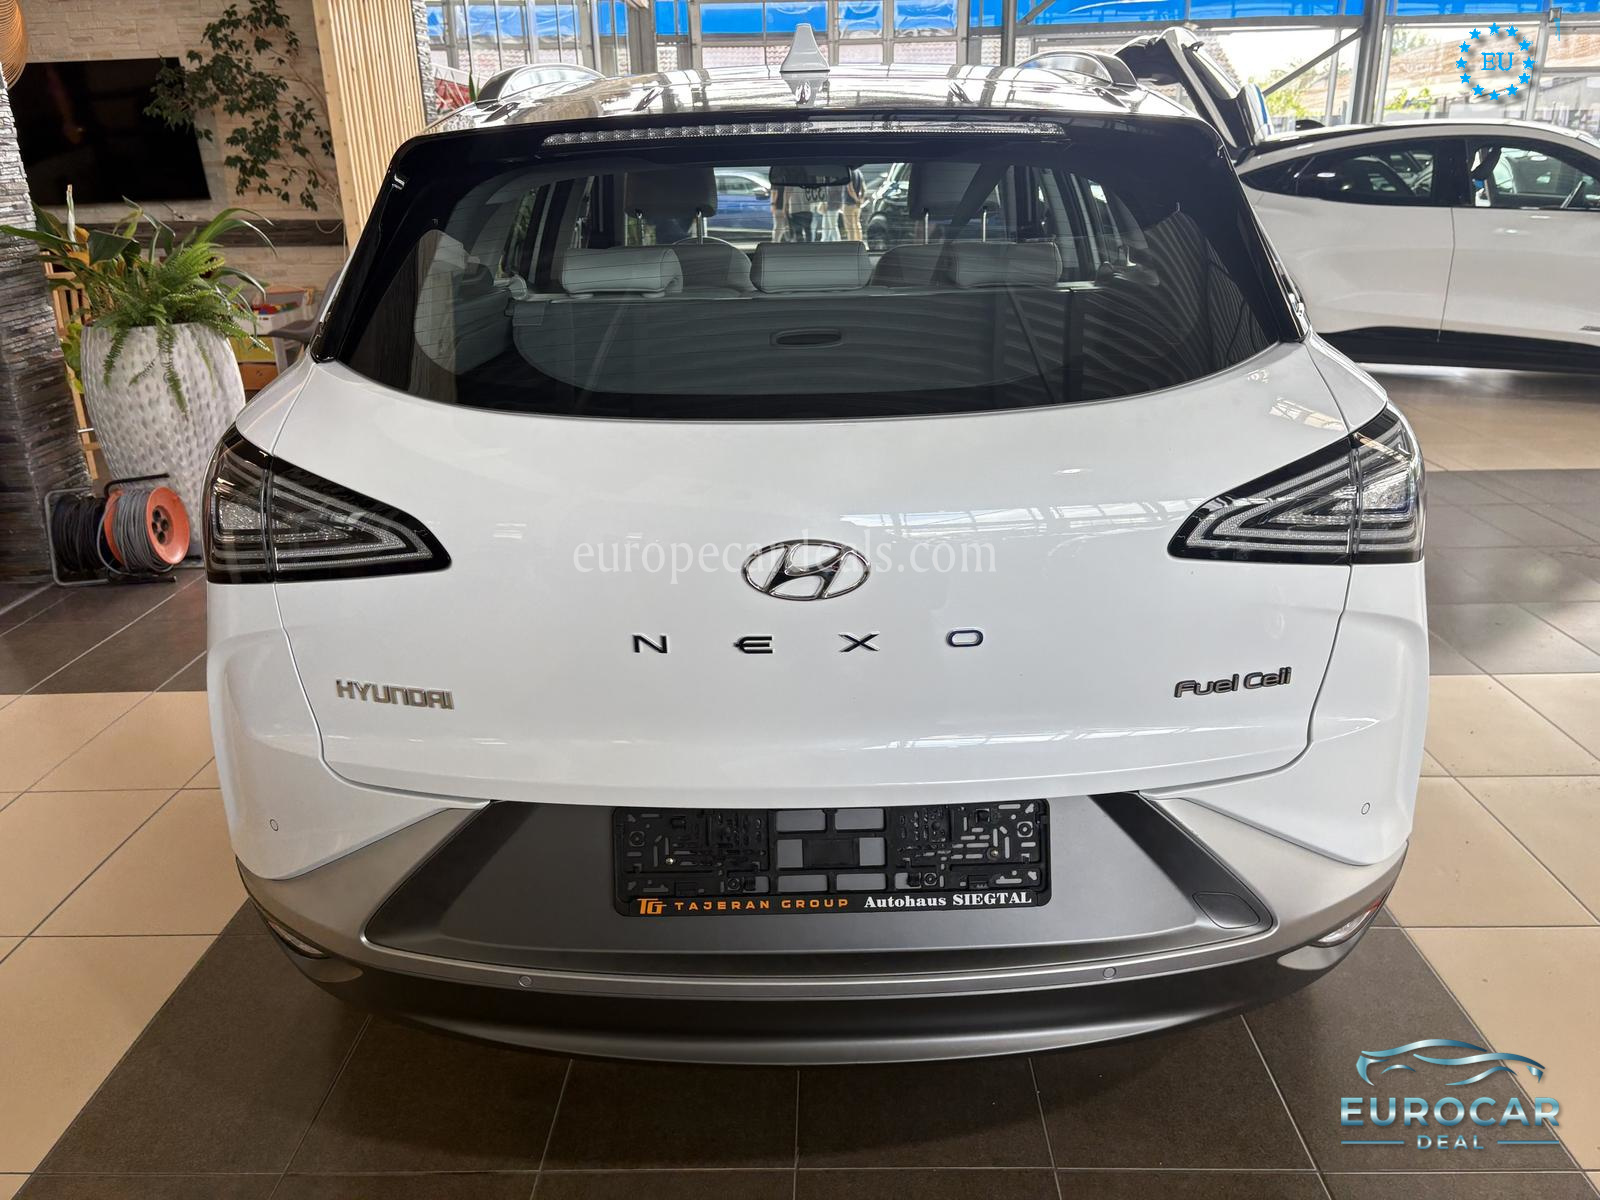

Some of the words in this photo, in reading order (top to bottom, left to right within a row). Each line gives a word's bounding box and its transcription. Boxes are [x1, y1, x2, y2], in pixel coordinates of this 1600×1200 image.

[631, 628, 984, 654] NEXO
[335, 678, 455, 710] HYUNDAI
[1173, 673, 1240, 699] Fuel
[1242, 666, 1292, 690] Cell
[674, 900, 770, 911] TAJERAN
[781, 898, 849, 909] GROUP
[863, 895, 947, 909] Autohaus
[952, 891, 1033, 906] SIEGTAL
